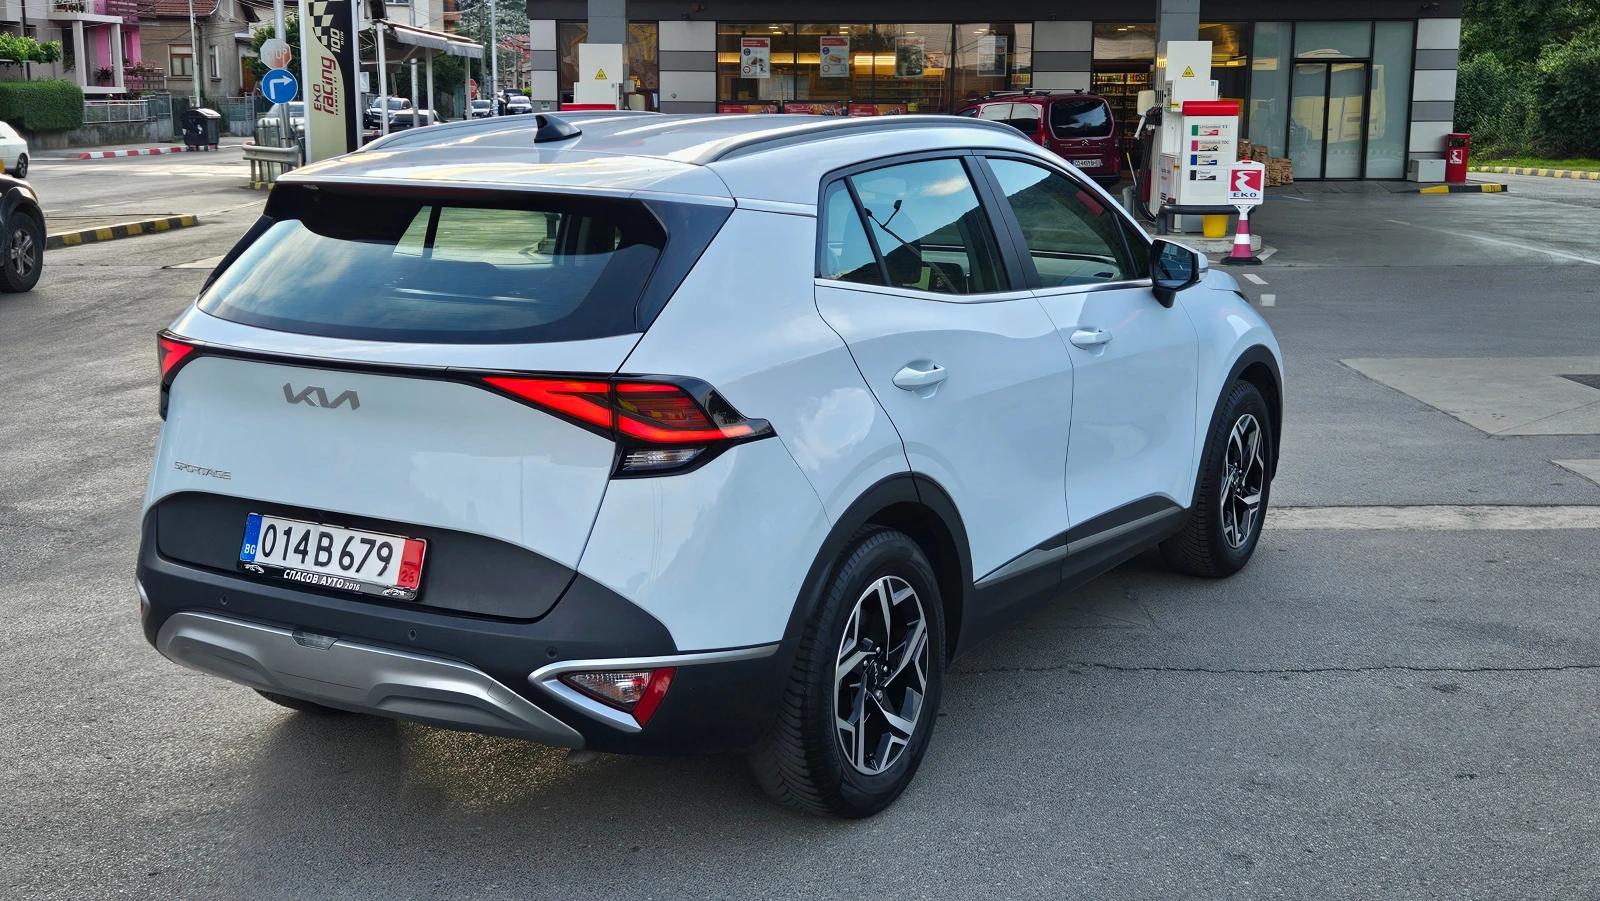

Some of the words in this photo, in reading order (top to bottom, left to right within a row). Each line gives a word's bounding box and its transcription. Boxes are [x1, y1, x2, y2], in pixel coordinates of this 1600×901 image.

[330, 28, 341, 53] 100
[313, 84, 322, 111] EKO
[321, 56, 337, 115] racing
[283, 382, 360, 411] KIA
[174, 461, 232, 480] SPORTAGE
[244, 543, 256, 555] BG
[261, 523, 394, 577] 014B679
[283, 569, 320, 584] СПАСОВ
[319, 574, 344, 588] АУТО
[344, 582, 361, 592] 2016
[400, 569, 415, 584] 26
